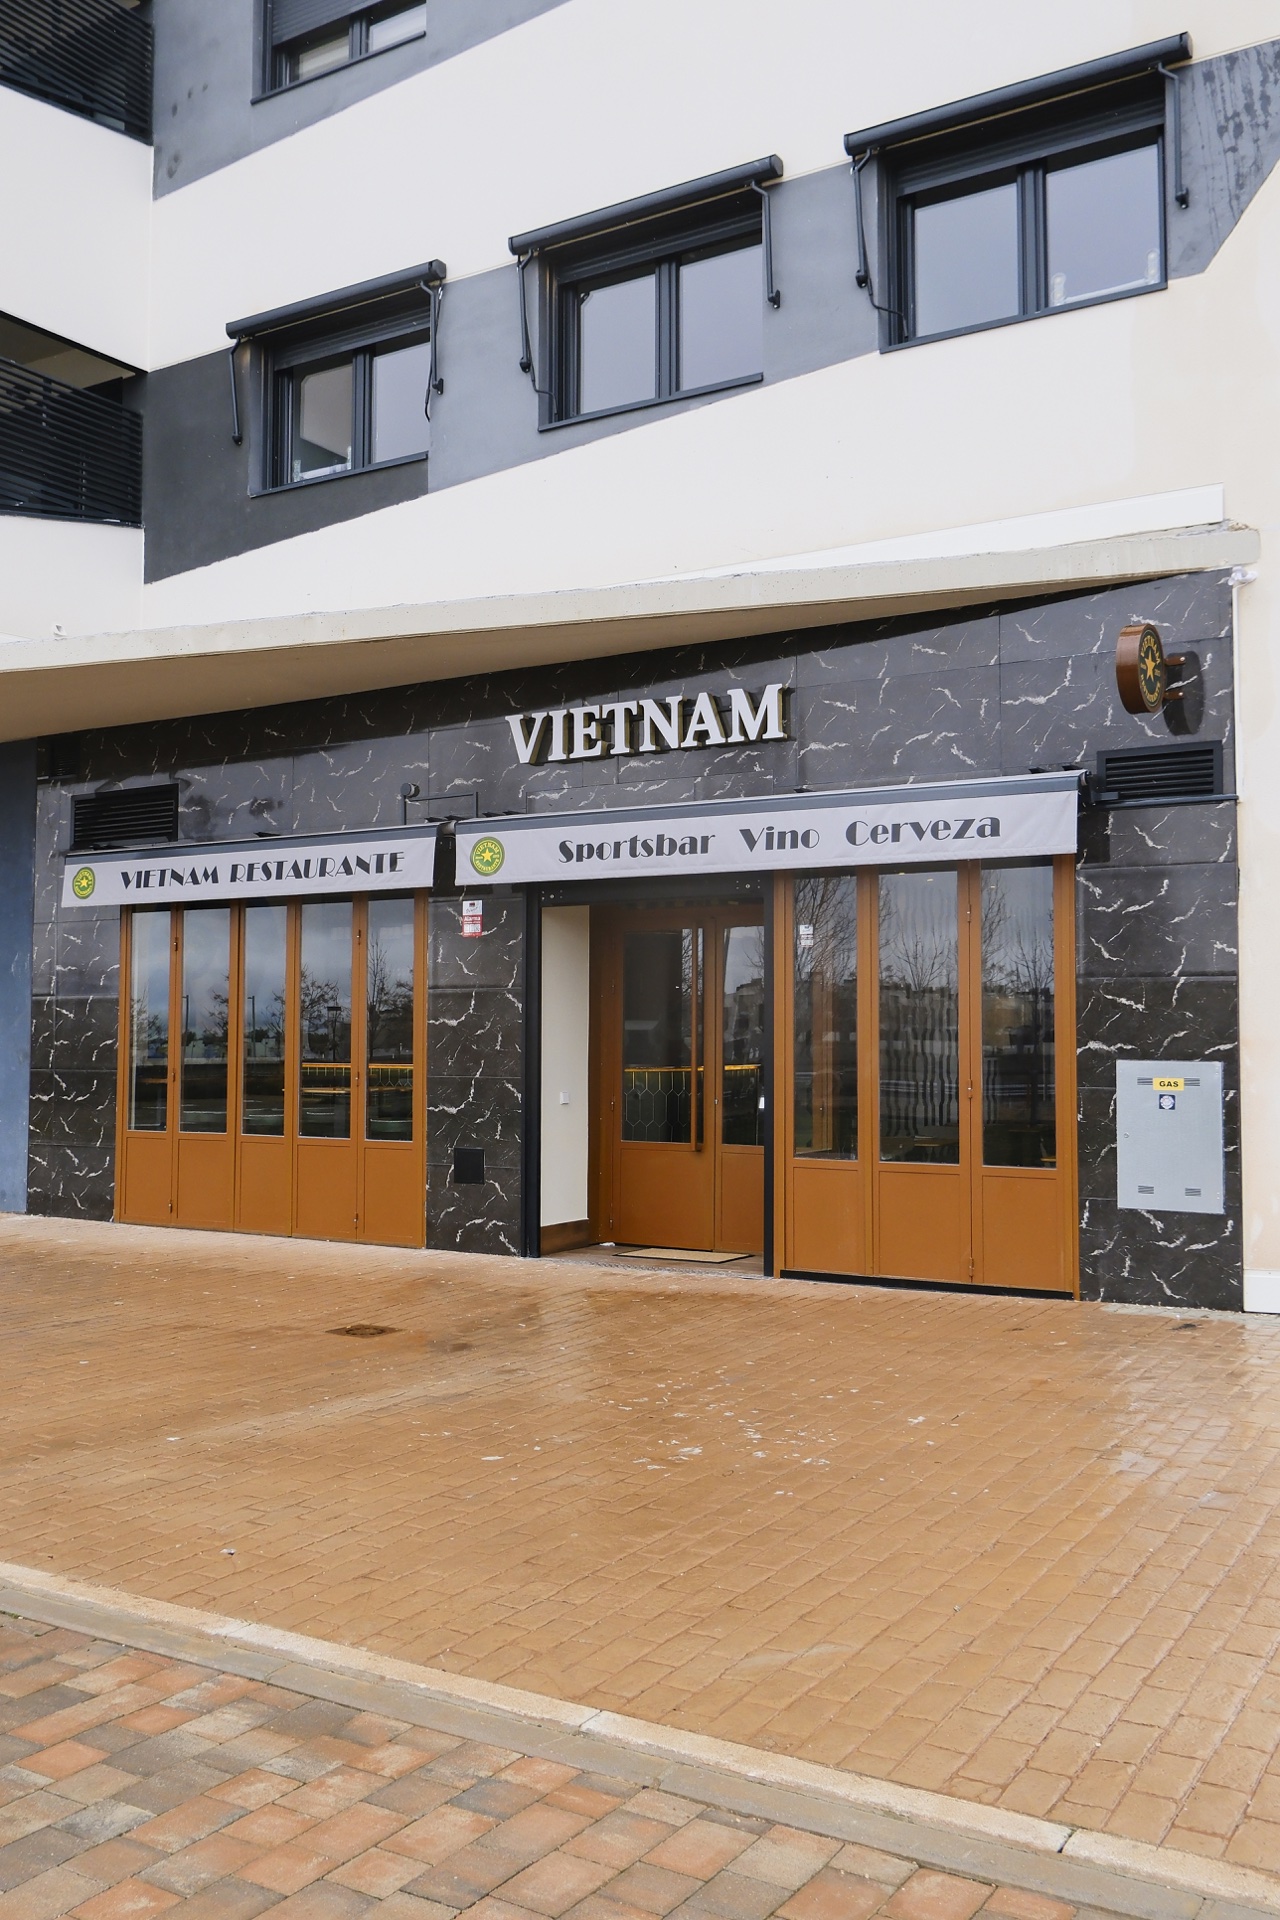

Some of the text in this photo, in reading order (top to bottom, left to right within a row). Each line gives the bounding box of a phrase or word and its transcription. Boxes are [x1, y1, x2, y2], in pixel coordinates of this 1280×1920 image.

[505, 684, 787, 764] VIETNAM
[558, 816, 1001, 864] Sportsbar Vino Cerveza
[120, 851, 405, 890] VIETNAM RESTAURANTE
[1159, 1080, 1179, 1088] GAS
